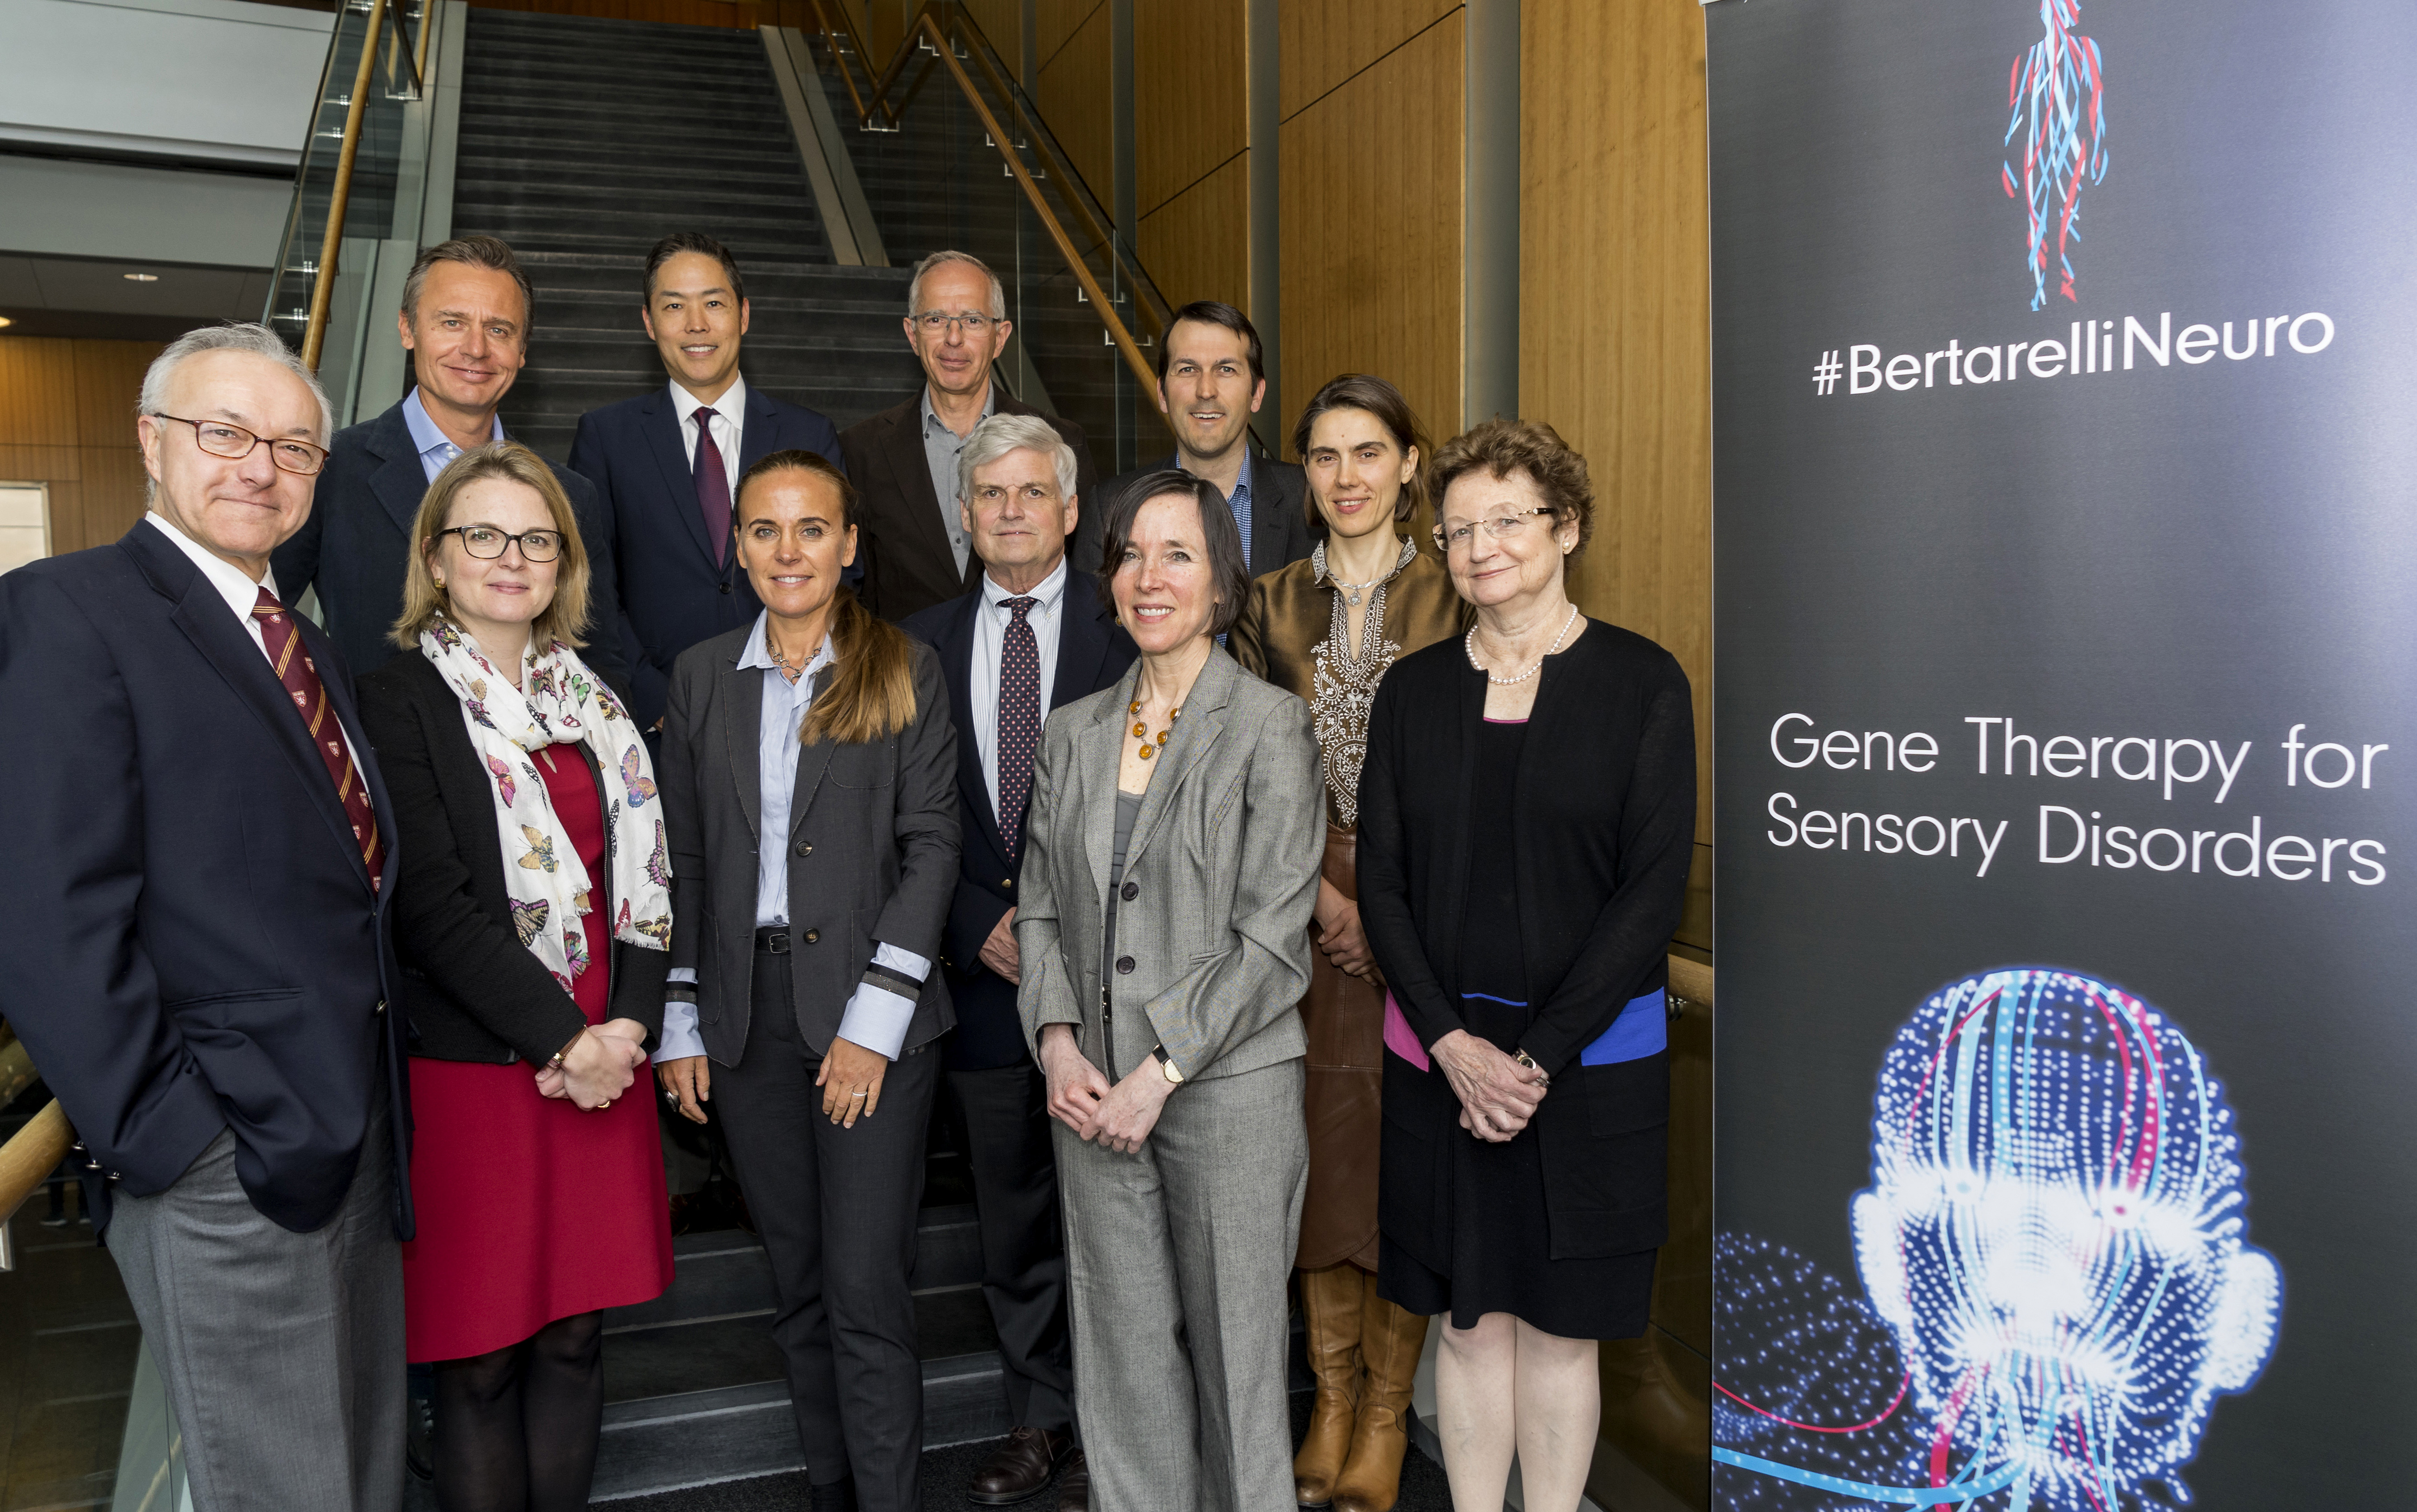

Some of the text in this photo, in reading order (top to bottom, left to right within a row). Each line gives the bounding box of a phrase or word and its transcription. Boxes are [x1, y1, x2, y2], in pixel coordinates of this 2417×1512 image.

[1812, 311, 2336, 396] #BertarelliNeuro
[1770, 713, 2389, 804] Gene Therapy for
[1767, 792, 2386, 886] Sensory Disorders
